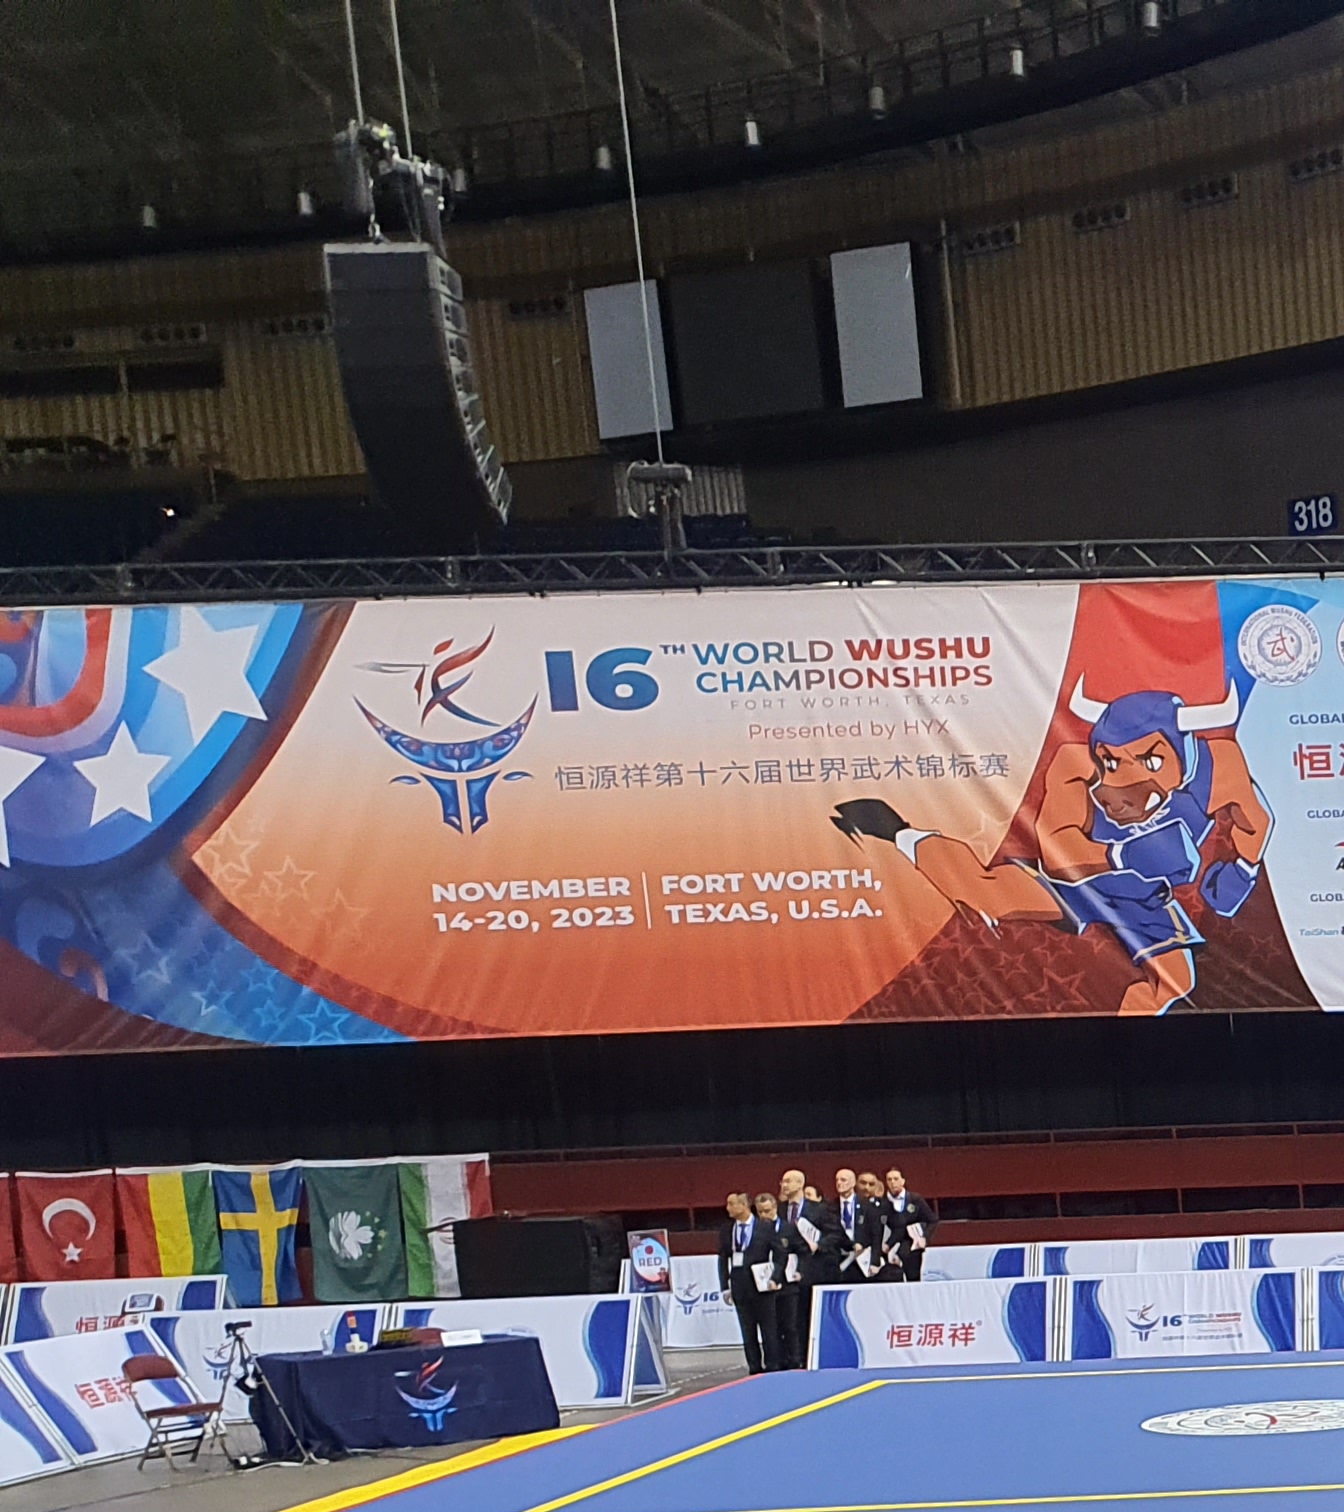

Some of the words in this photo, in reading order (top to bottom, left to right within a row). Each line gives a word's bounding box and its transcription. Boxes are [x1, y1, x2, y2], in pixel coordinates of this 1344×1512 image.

[1293, 496, 1333, 532] 318
[691, 640, 834, 667] WORLD
[844, 636, 991, 662] WUSHU
[695, 664, 993, 694] CHAMPIONSHIPS
[730, 698, 786, 711] FORT
[904, 693, 971, 707] TEXAS
[748, 720, 862, 740] Presented
[870, 719, 896, 740] by
[904, 718, 950, 736] HYX
[554, 752, 1011, 792] 恒源祥第十六届世界武术锦标赛
[431, 876, 632, 903] NOVEMBER
[661, 872, 745, 896] FORT
[752, 868, 882, 893] WORTH,
[432, 909, 540, 933] 14-20,
[550, 905, 635, 930] 2023
[664, 901, 778, 926] TEXAS,
[789, 898, 883, 920] U.S.A.
[638, 1256, 663, 1268] RED
[703, 1291, 720, 1303] 16
[886, 1321, 977, 1349] 恒源祥
[1162, 1314, 1183, 1328] 16
